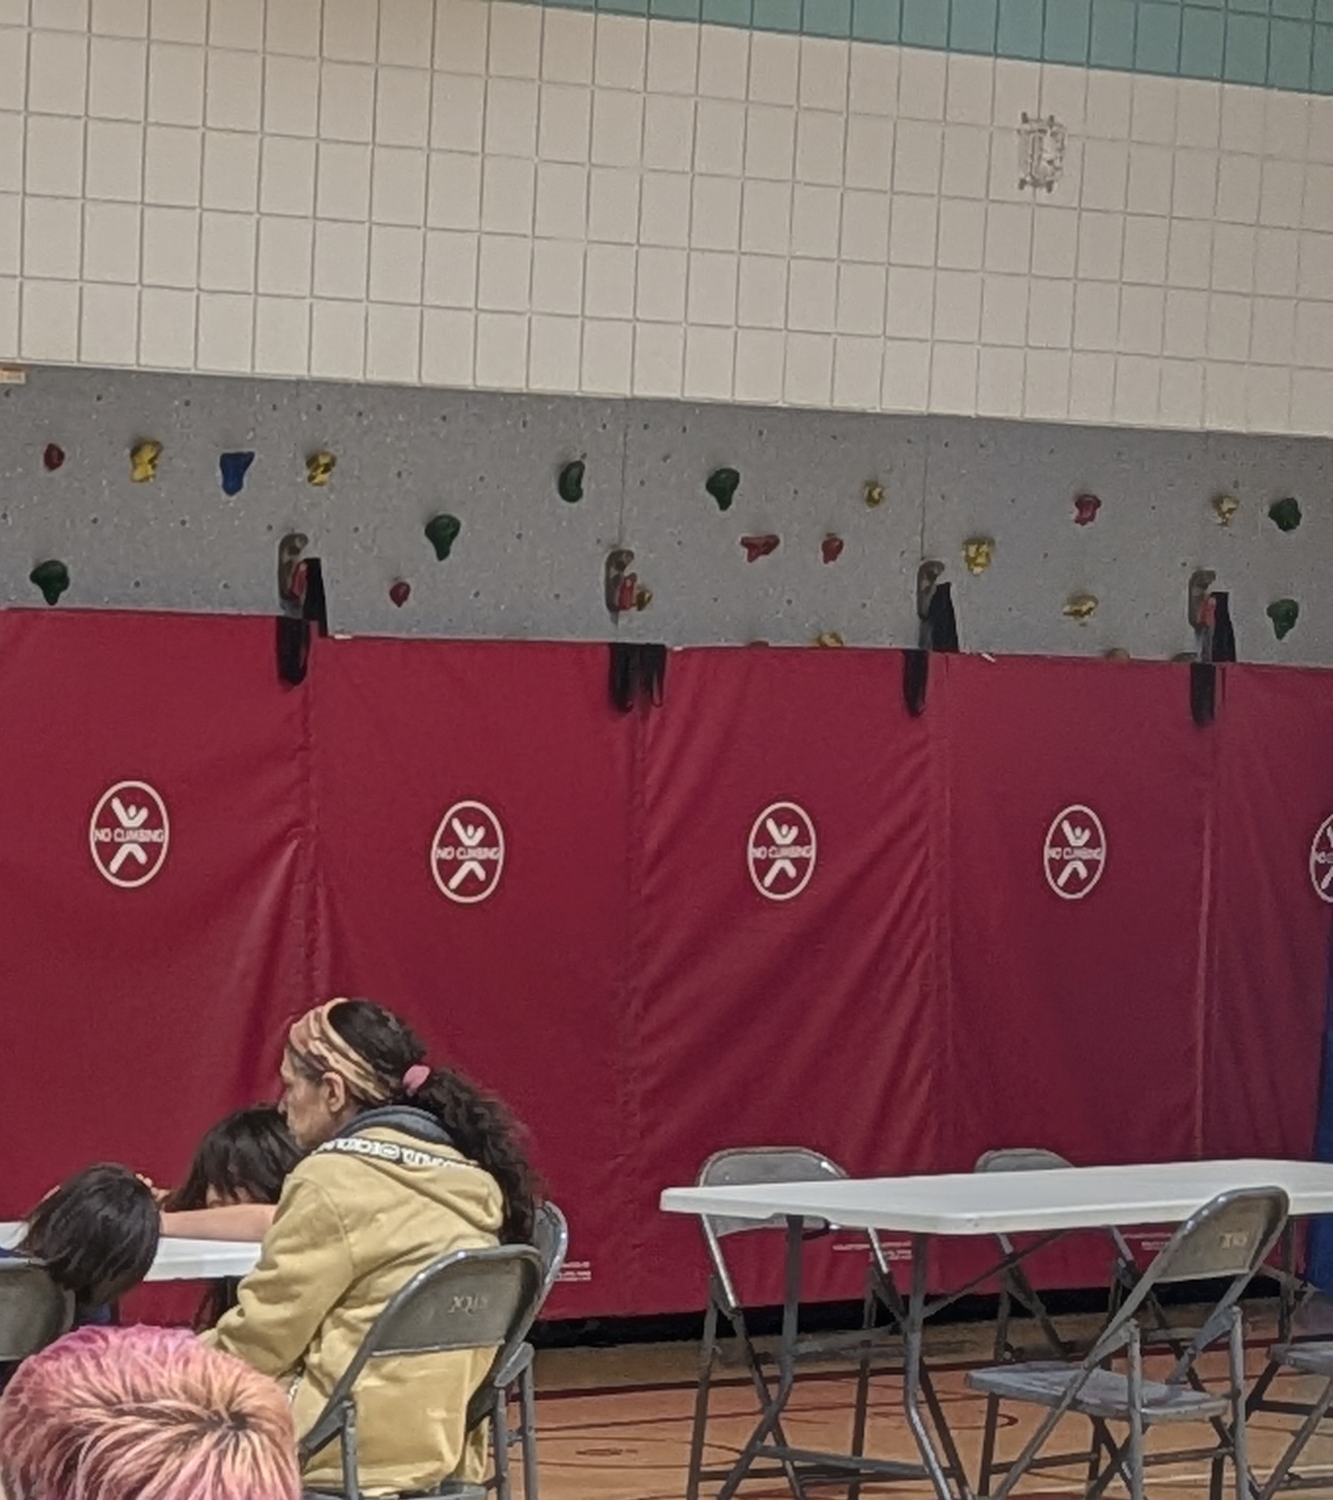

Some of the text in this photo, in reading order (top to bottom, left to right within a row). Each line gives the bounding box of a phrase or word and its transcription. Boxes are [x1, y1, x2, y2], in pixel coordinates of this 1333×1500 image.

[94, 828, 112, 842] NO
[435, 846, 455, 860] NO
[752, 846, 767, 860] NO
[1048, 847, 1062, 860] NO
